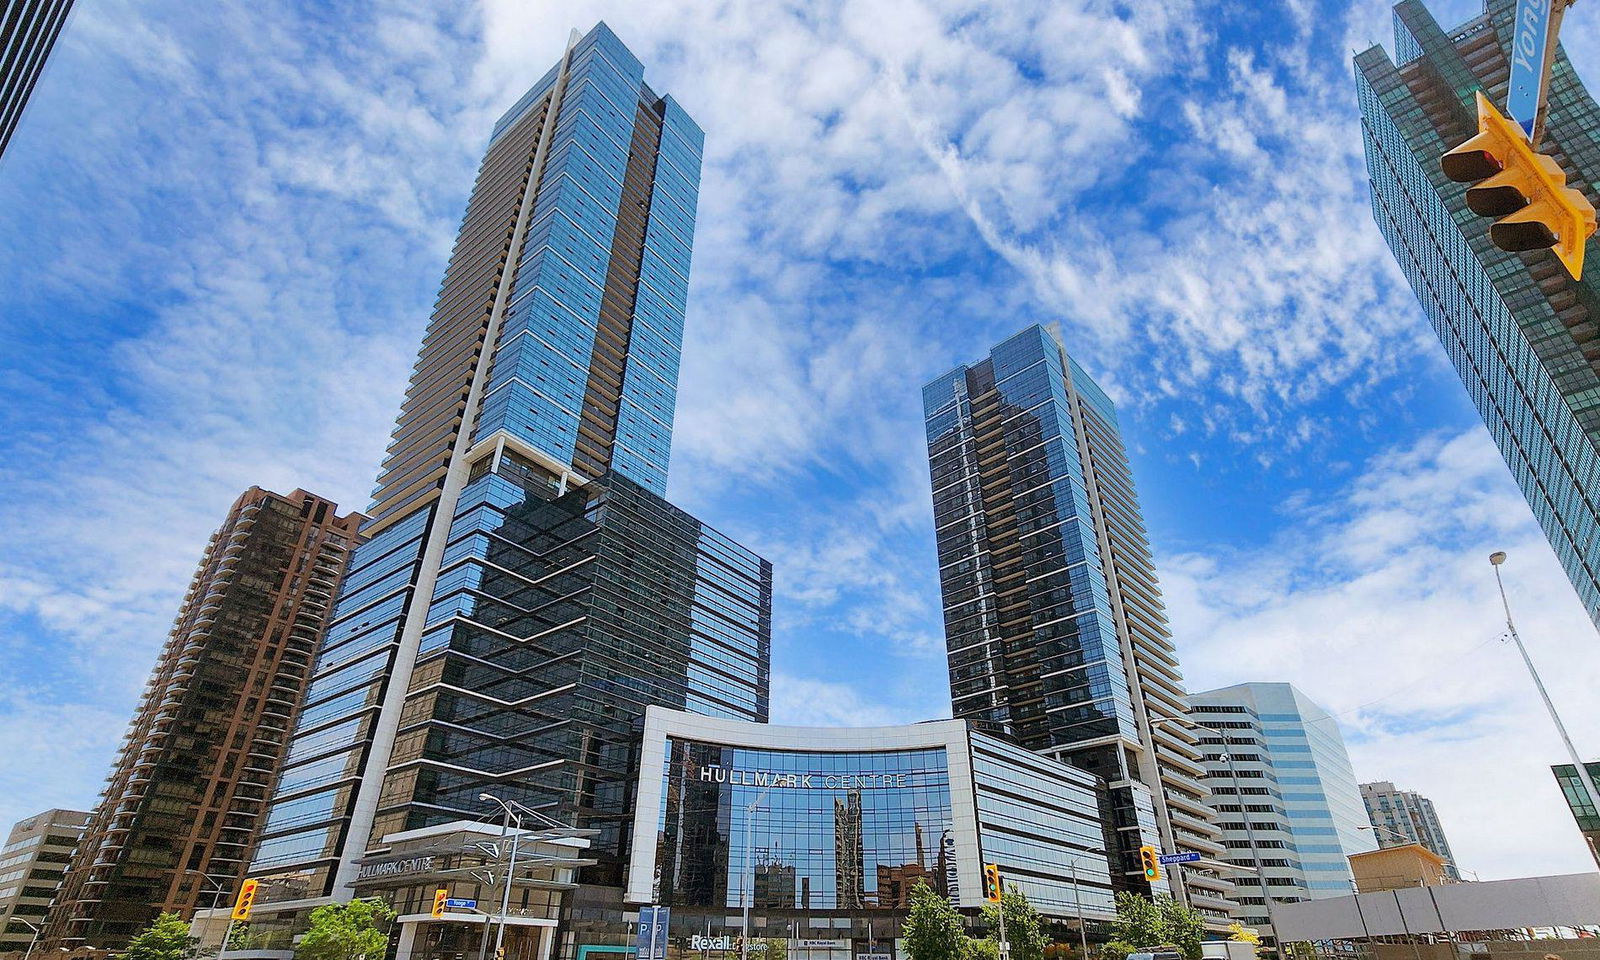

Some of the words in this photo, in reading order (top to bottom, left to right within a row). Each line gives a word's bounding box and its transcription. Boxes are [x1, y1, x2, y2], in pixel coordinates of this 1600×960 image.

[700, 766, 813, 788] HULLMARK
[825, 774, 906, 789] CENTRE
[355, 862, 398, 881] HULLMARK
[397, 857, 436, 872] CENTRE
[1161, 854, 1190, 864] Sheppard
[691, 934, 730, 951] Rexall
[732, 942, 768, 952] dgstore
